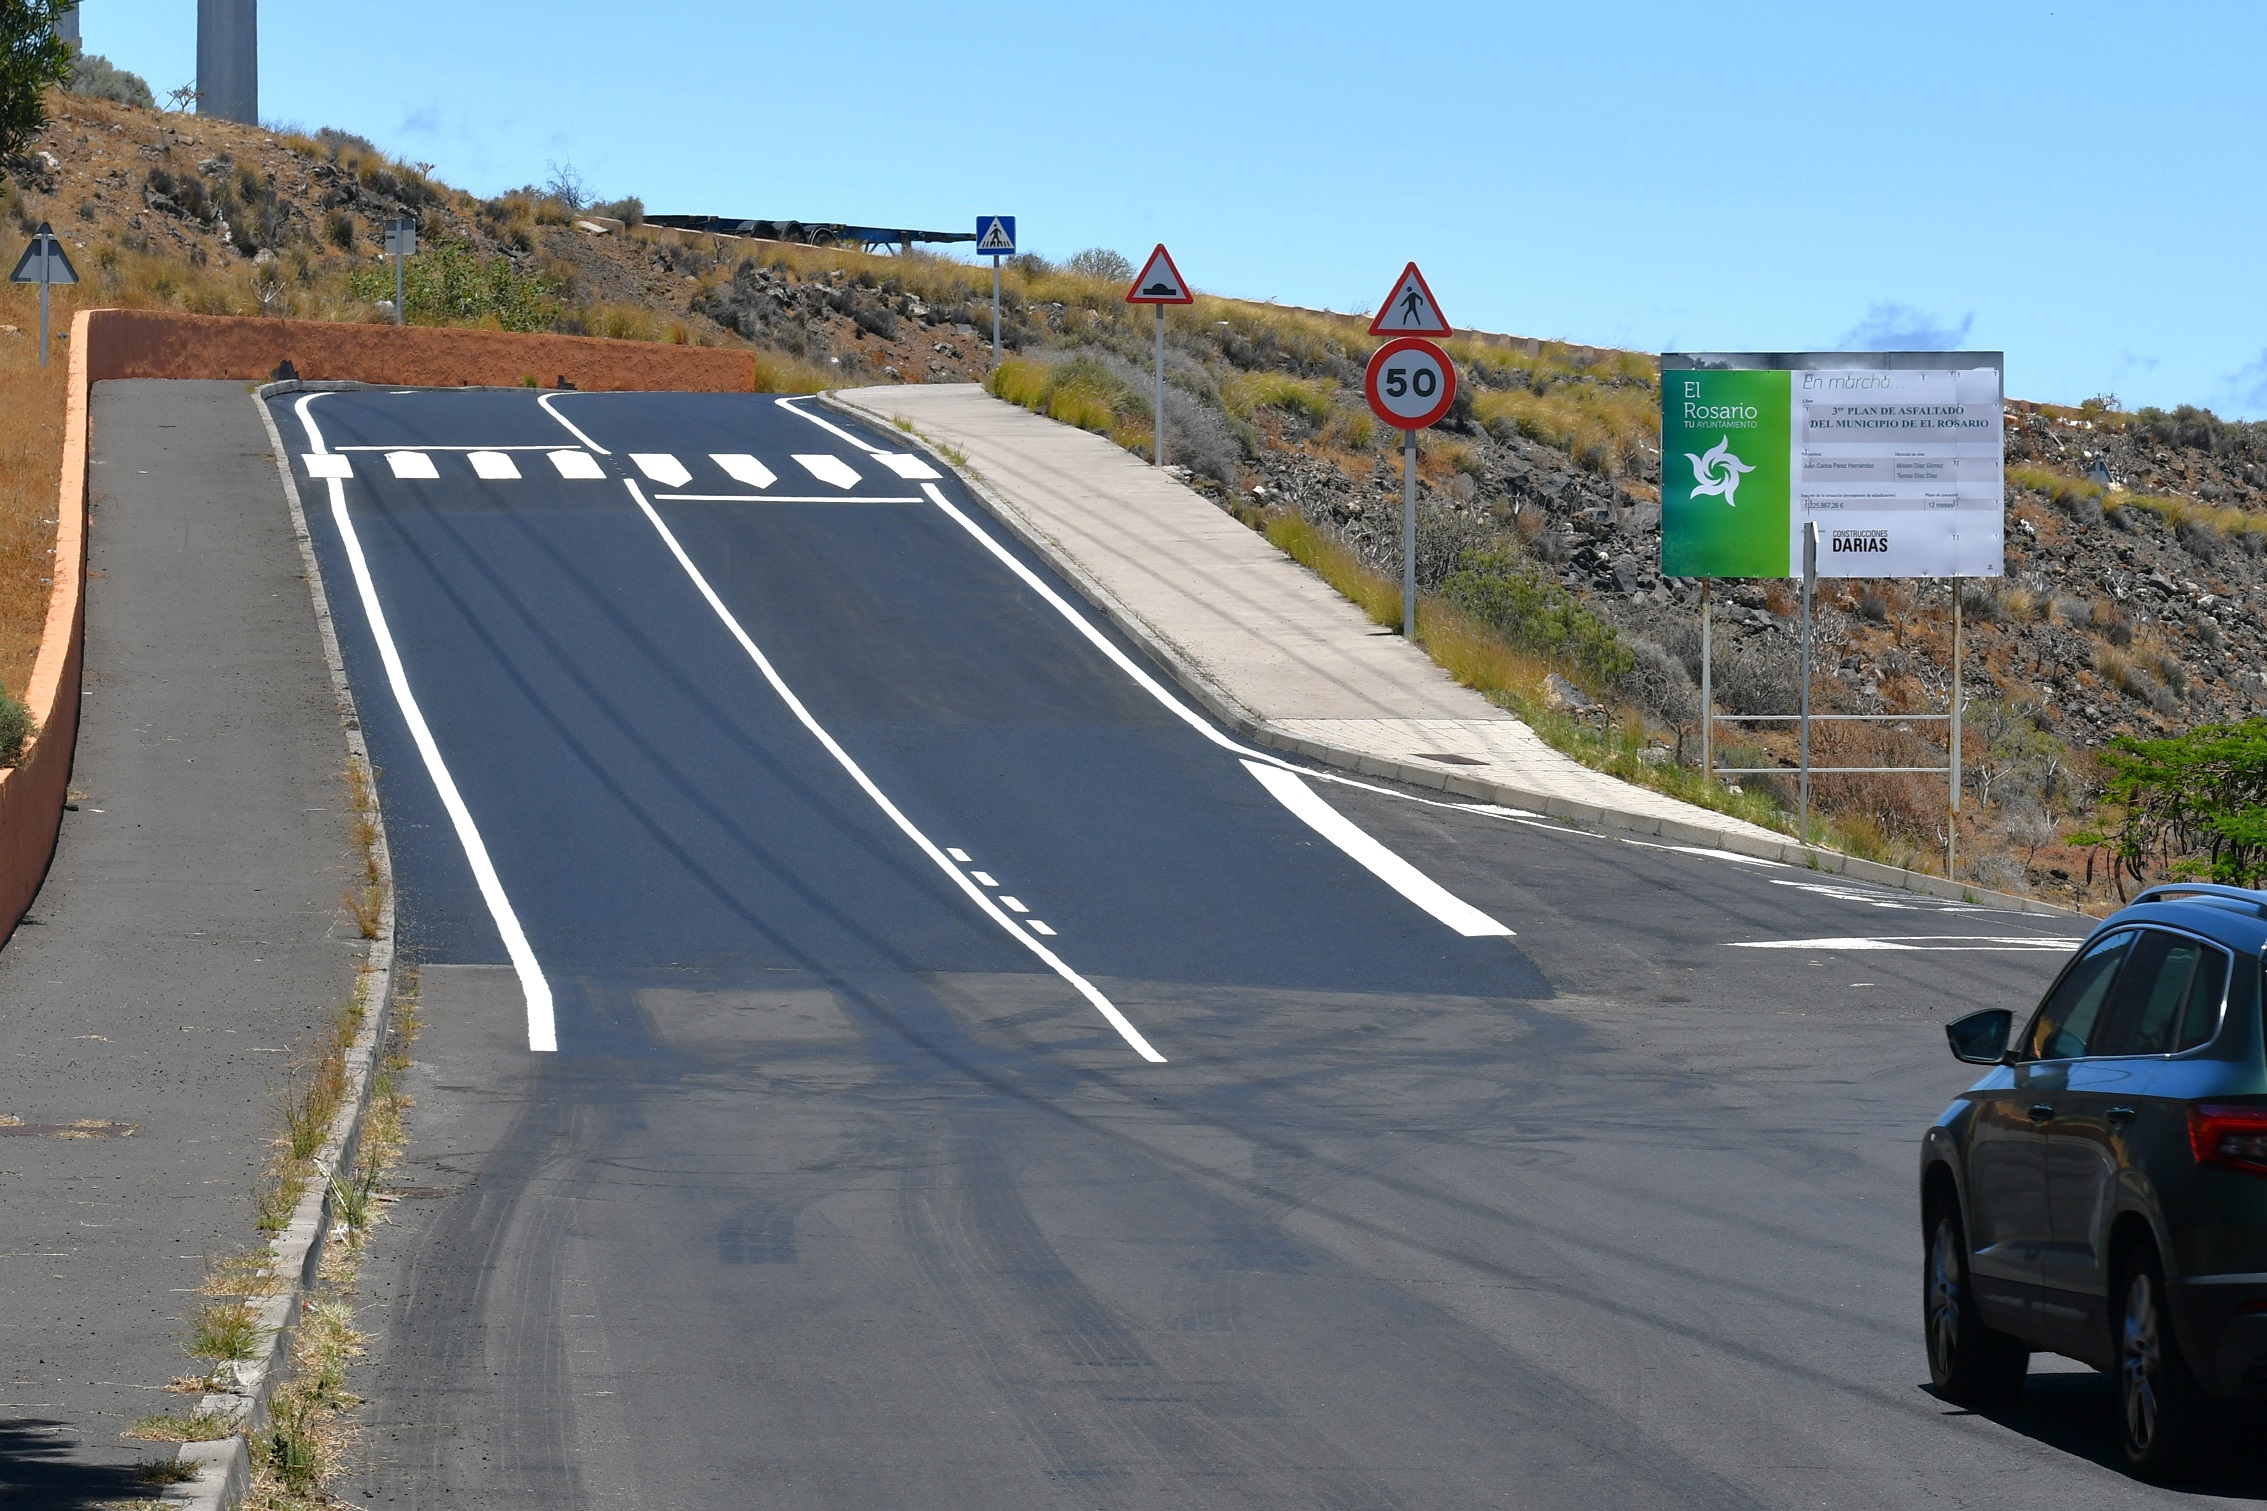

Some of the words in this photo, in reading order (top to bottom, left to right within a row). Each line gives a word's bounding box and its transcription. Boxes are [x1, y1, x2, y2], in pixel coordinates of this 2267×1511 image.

[1386, 368, 1437, 398] 50
[1802, 373, 1823, 390] En
[1684, 381, 1701, 399] El
[1683, 402, 1758, 419] Rosario
[1847, 407, 1878, 416] PLAN
[1880, 407, 1896, 416] DE
[1898, 406, 1965, 416] ASFALTADO
[1683, 420, 1695, 429] TU
[1696, 420, 1758, 429] AYUNTAMIENTO
[1810, 419, 1834, 429] DEL
[1836, 419, 1899, 429] MUNICIPIO
[1902, 419, 1918, 429] DE
[1920, 419, 1936, 429] EL
[1937, 419, 1989, 429] ROSARIO
[1832, 530, 1888, 538] CONSTRUCCIONES
[1832, 538, 1888, 553] DARIAS
